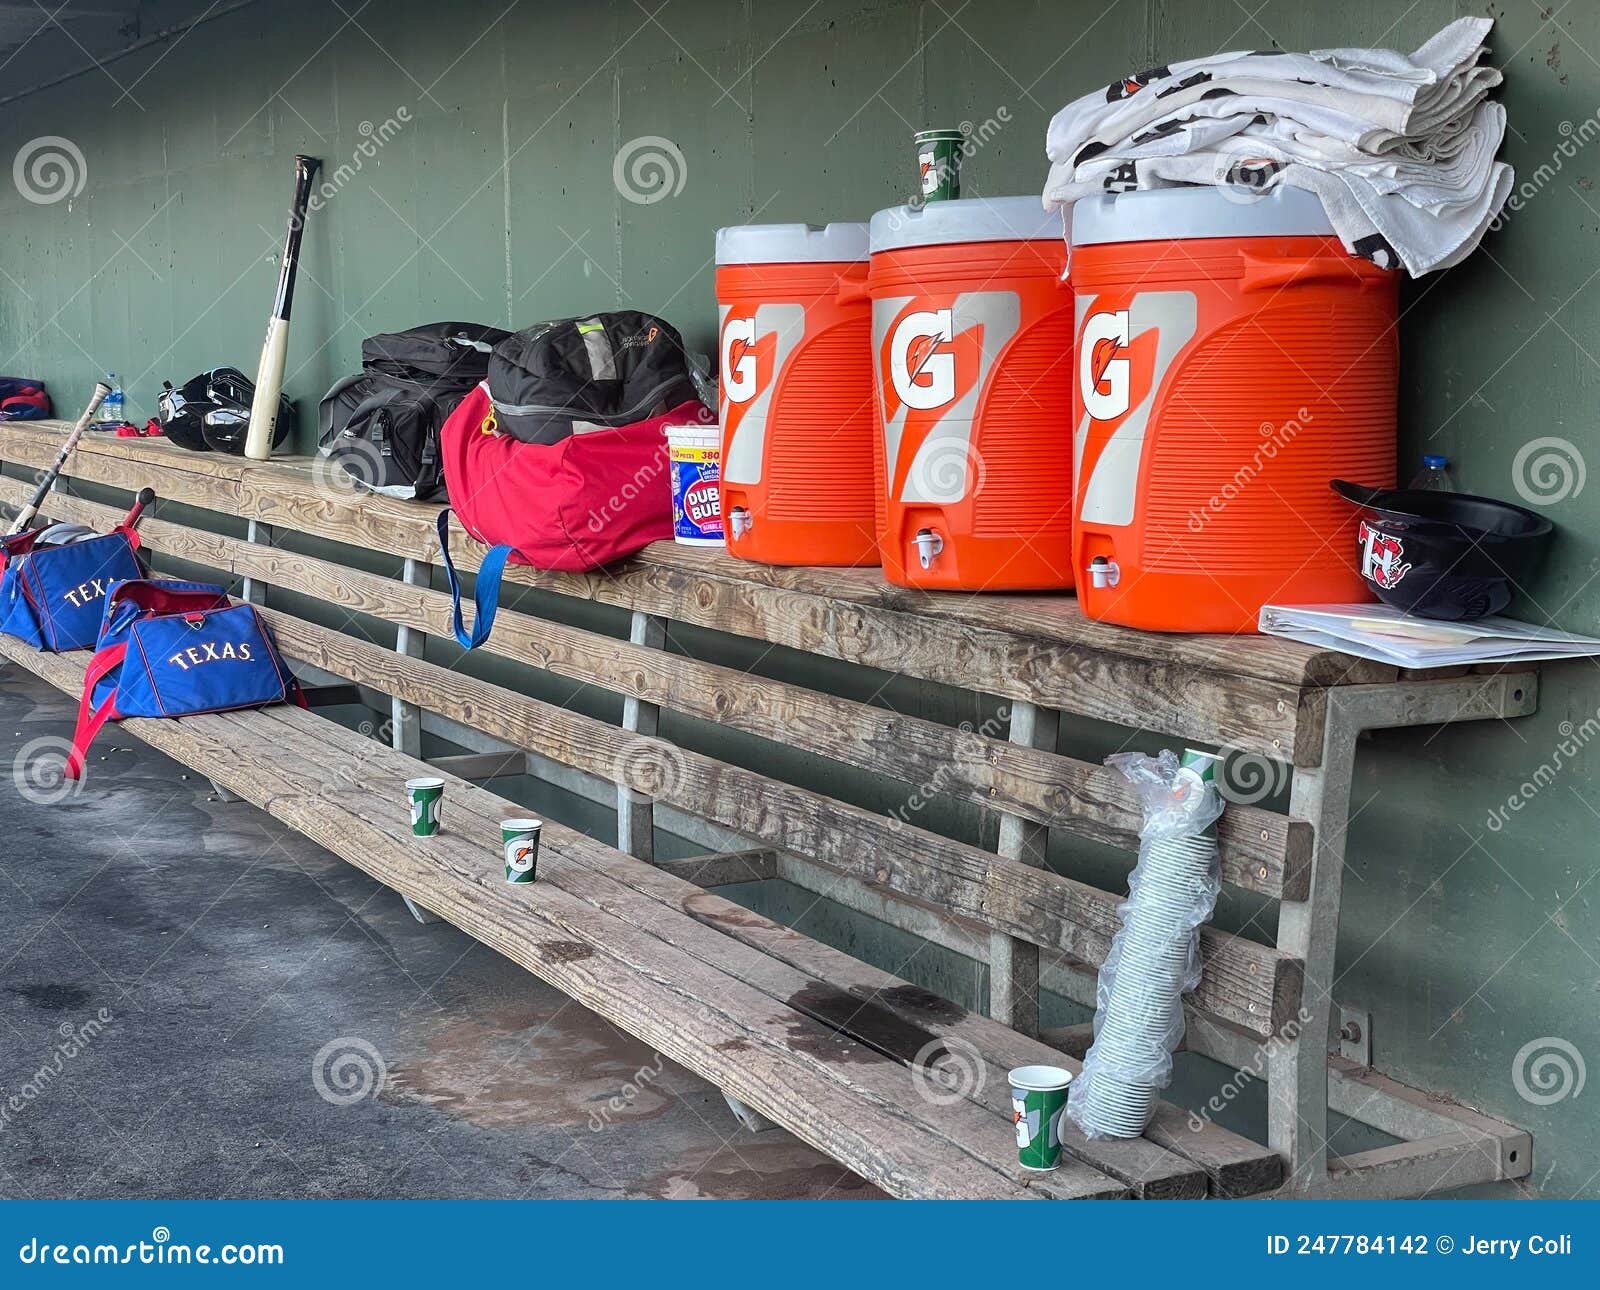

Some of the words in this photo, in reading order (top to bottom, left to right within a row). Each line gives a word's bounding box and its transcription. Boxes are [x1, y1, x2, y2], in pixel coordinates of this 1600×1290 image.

[722, 317, 757, 403] G
[889, 308, 956, 410] G
[1080, 310, 1130, 421] G
[701, 451, 720, 460] 380
[687, 487, 720, 506] DUB
[691, 502, 721, 520] BUB
[64, 577, 127, 607] TEX
[169, 642, 251, 670] TEXAS
[507, 839, 534, 872] G
